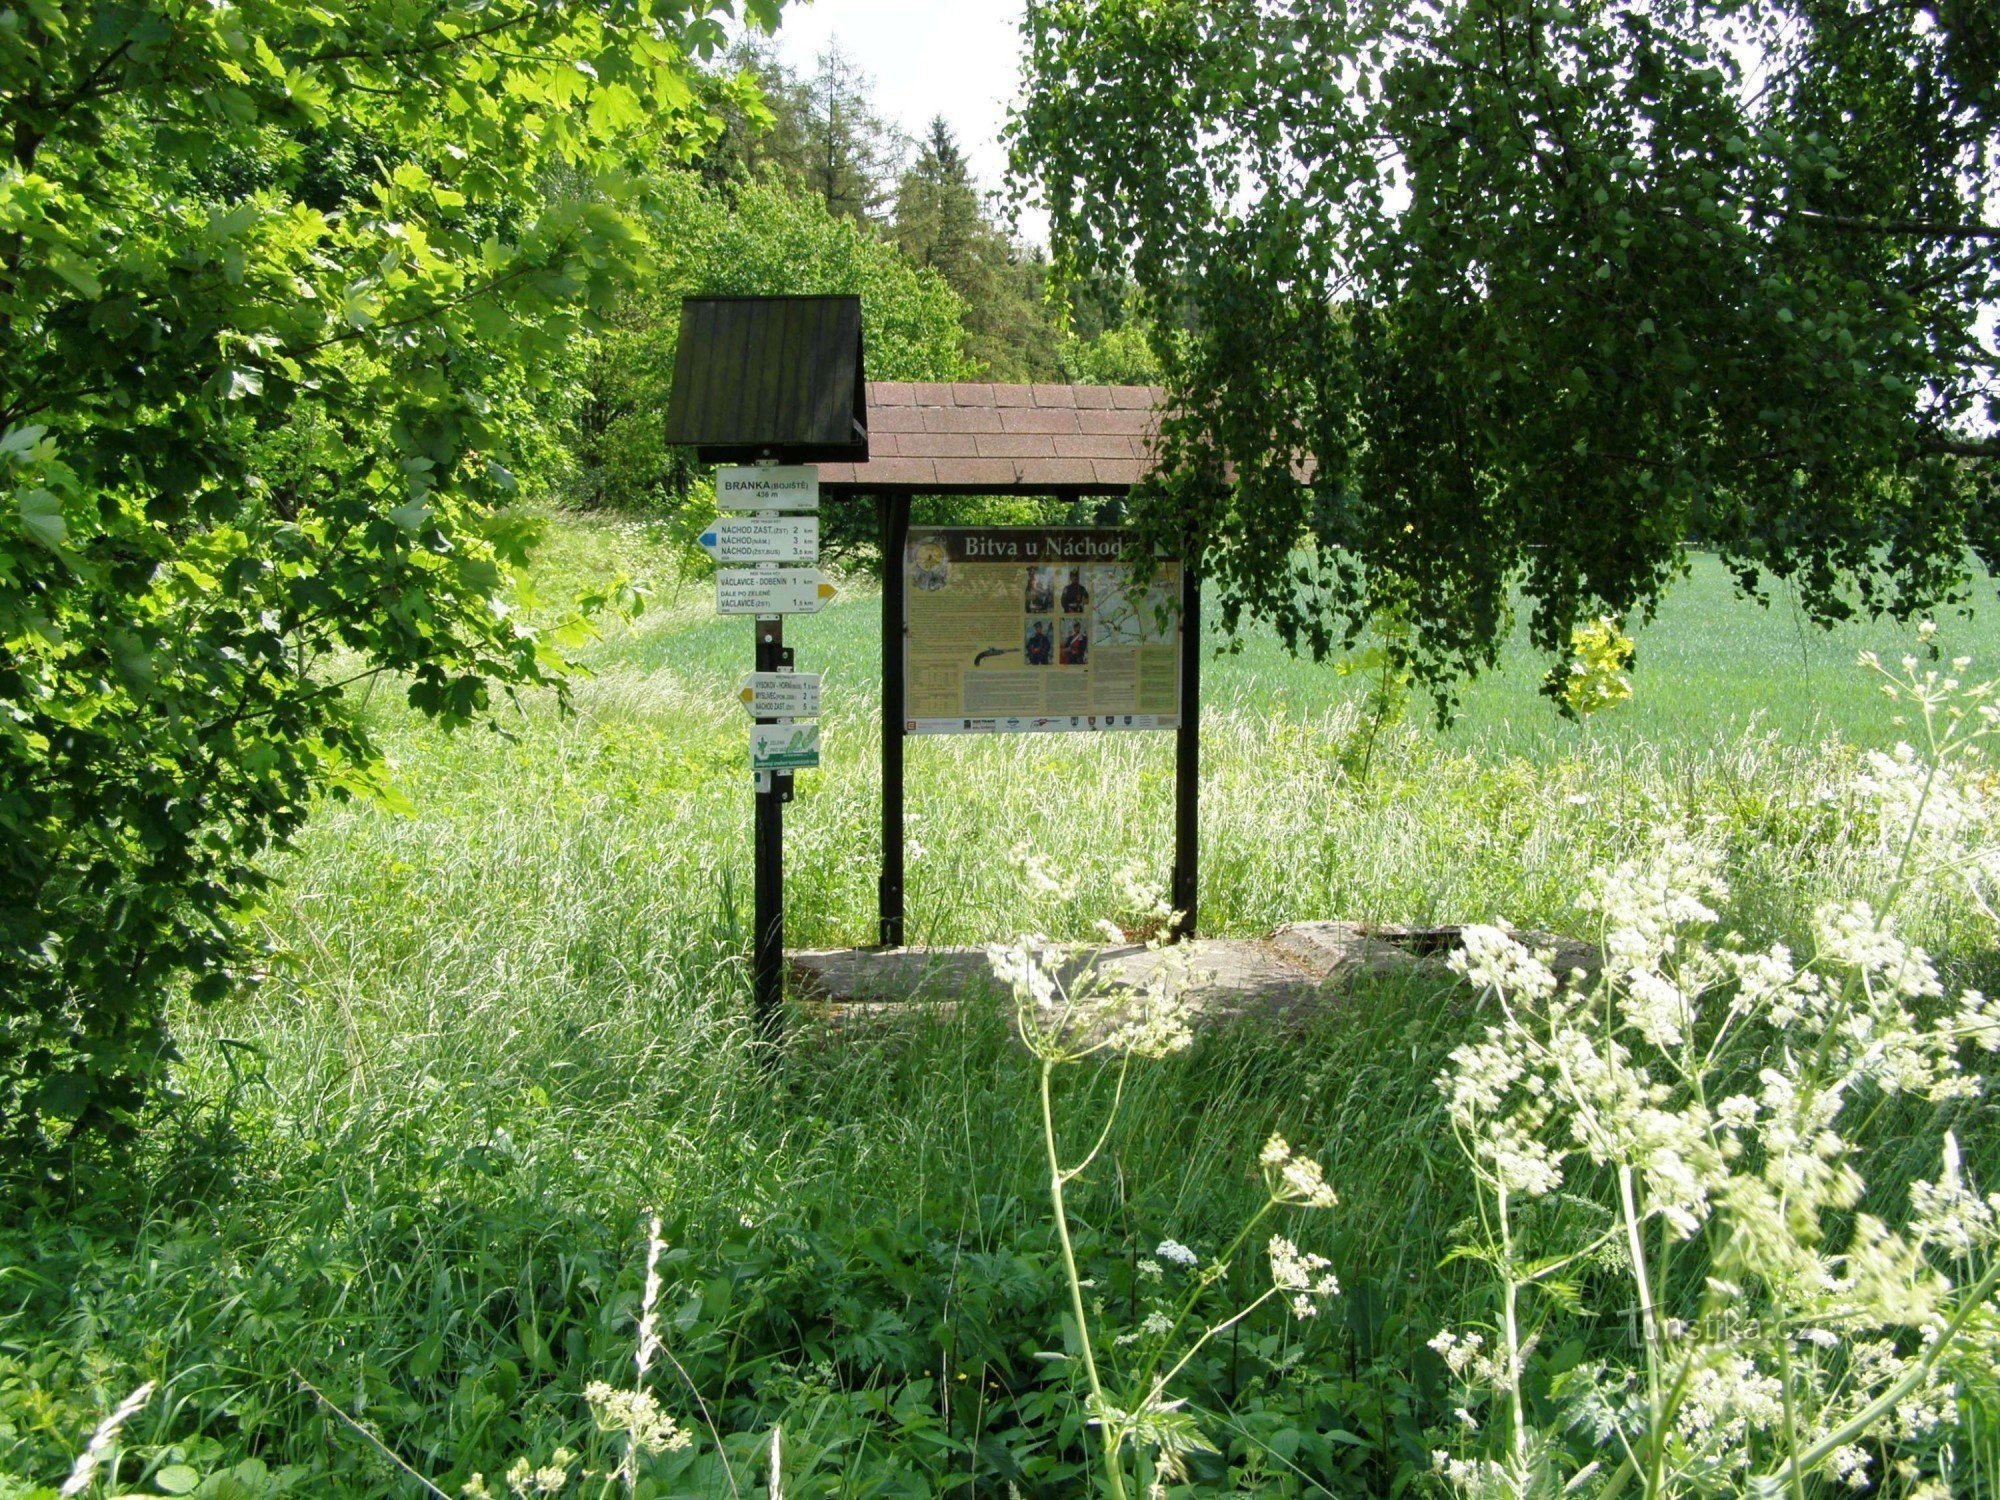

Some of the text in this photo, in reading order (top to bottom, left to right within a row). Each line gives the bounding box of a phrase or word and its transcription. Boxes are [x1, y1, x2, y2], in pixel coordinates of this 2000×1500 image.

[725, 481, 770, 490] BRANKA
[793, 526, 799, 534] 2
[721, 535, 752, 544] NÁCHOD
[793, 536, 799, 544] 3
[721, 546, 752, 555] NÁCHOD
[965, 537, 1018, 556] Bitva
[1026, 543, 1038, 556] u
[721, 577, 755, 586] VÁCLAVICE
[721, 598, 755, 607] VÁCLAVICE
